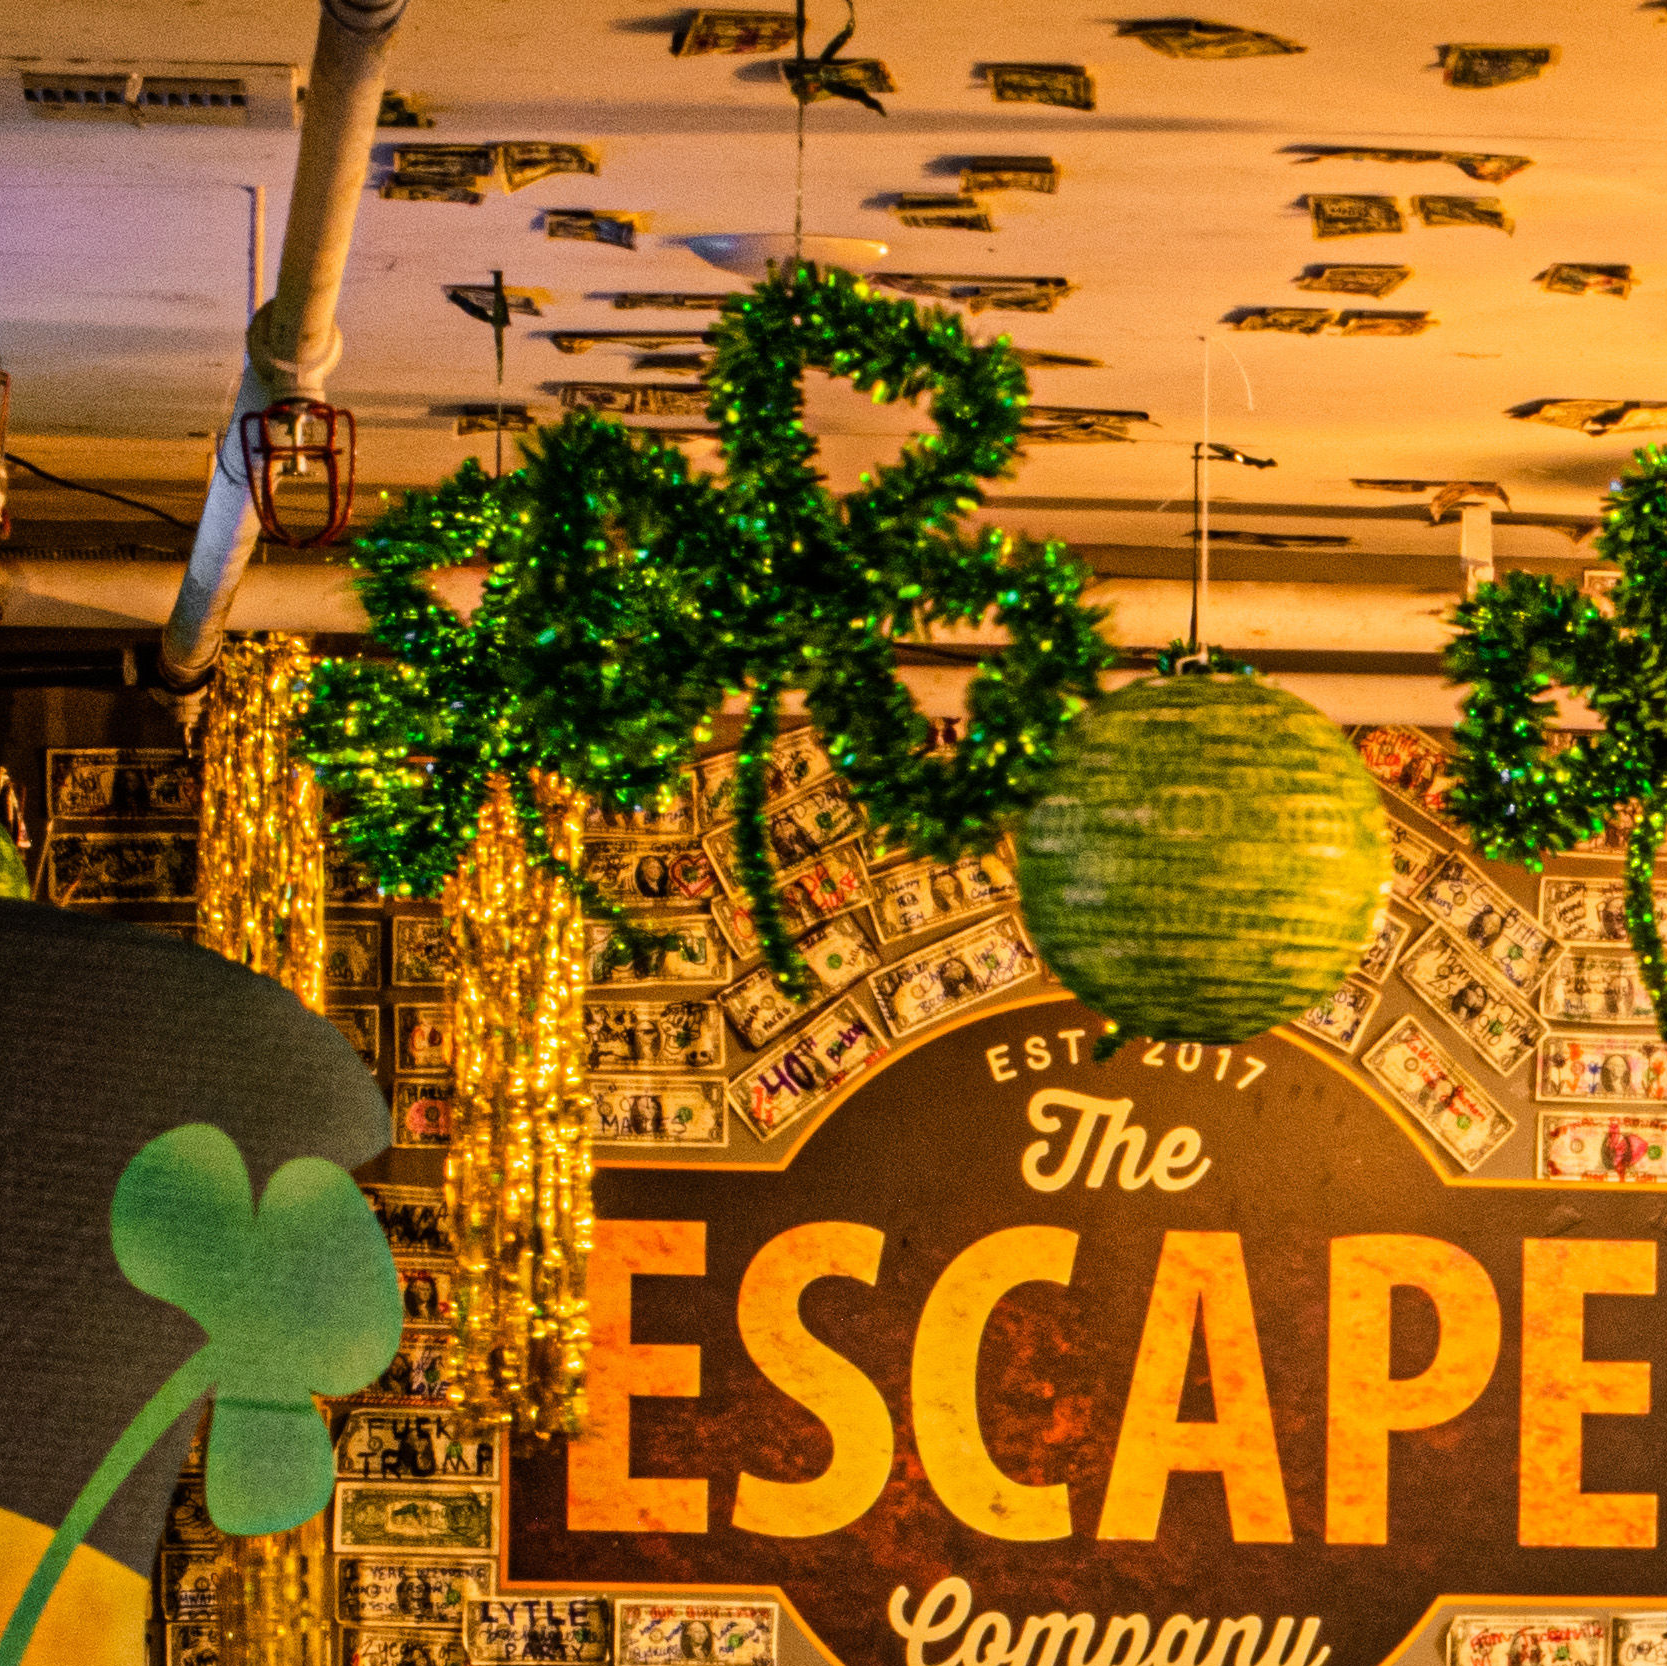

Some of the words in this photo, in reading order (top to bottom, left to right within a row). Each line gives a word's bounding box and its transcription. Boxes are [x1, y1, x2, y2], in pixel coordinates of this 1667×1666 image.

[986, 1029, 1086, 1081] EST
[1141, 1036, 1269, 1094] 2017
[1020, 1087, 1213, 1194] The
[567, 1219, 1660, 1549] ESCAPE
